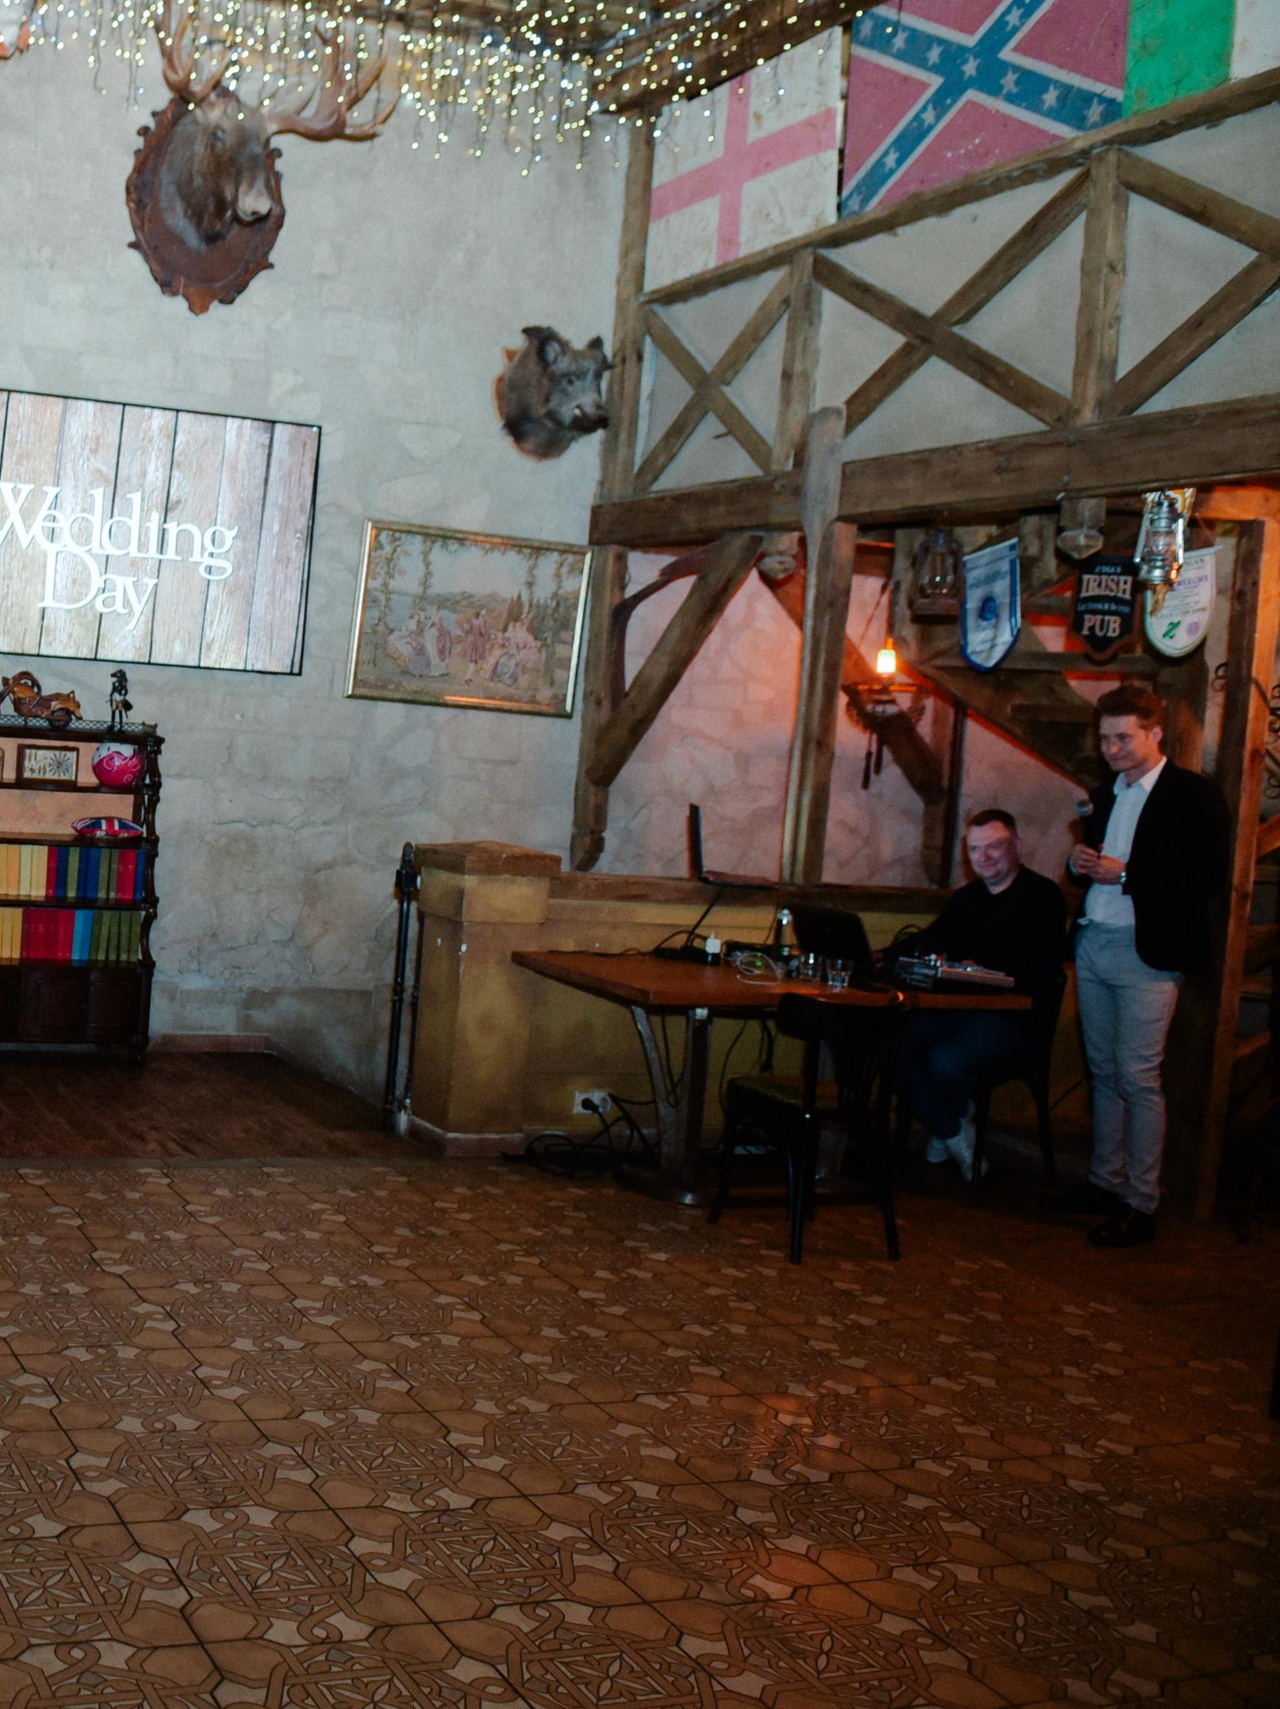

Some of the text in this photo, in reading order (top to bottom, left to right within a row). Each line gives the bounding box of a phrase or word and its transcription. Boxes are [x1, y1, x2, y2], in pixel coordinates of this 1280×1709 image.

[38, 547, 158, 631] Day
[1079, 574, 1134, 600] IRISH
[1080, 614, 1122, 638] PUB
